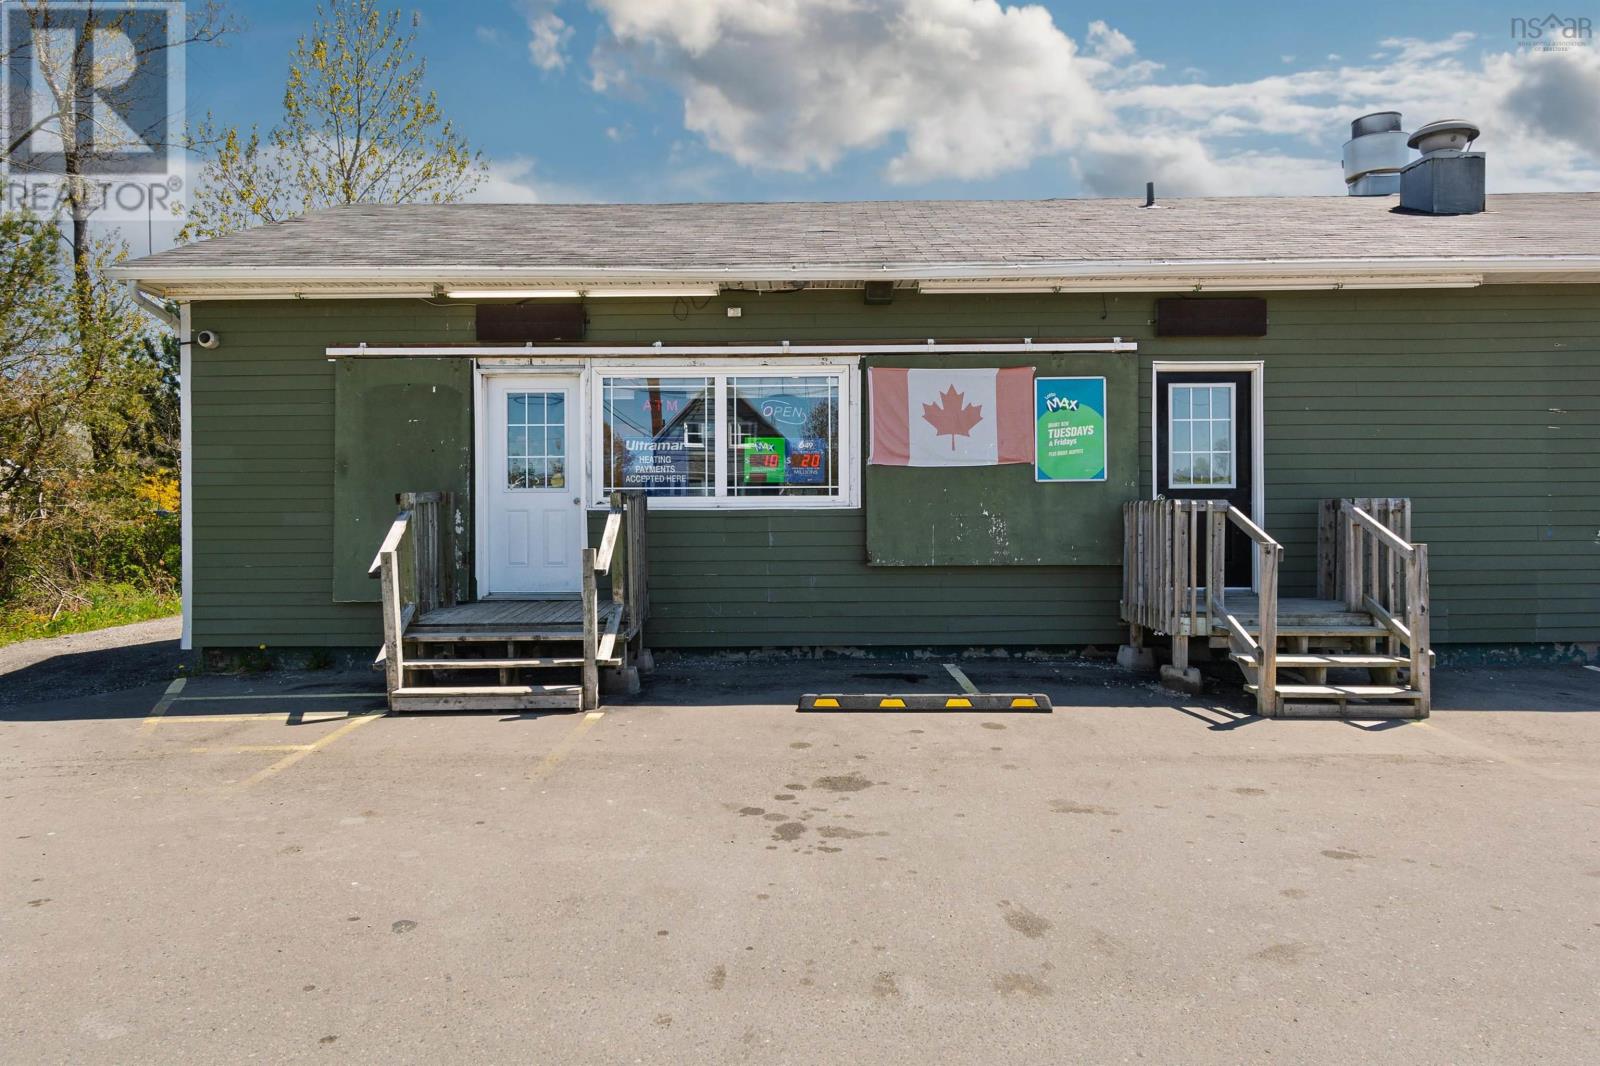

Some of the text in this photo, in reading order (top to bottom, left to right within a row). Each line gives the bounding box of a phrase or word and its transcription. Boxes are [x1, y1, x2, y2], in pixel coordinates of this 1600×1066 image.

[643, 400, 679, 411] ATM
[1047, 397, 1078, 412] MAX
[763, 406, 803, 417] OPEN
[1048, 425, 1094, 438] TUESDAYS
[626, 440, 685, 450] Ultramar
[1054, 438, 1077, 446] Fridays
[802, 454, 820, 467] 20
[636, 465, 675, 473] PAYMENTS
[626, 475, 664, 483] ACCEPTED
